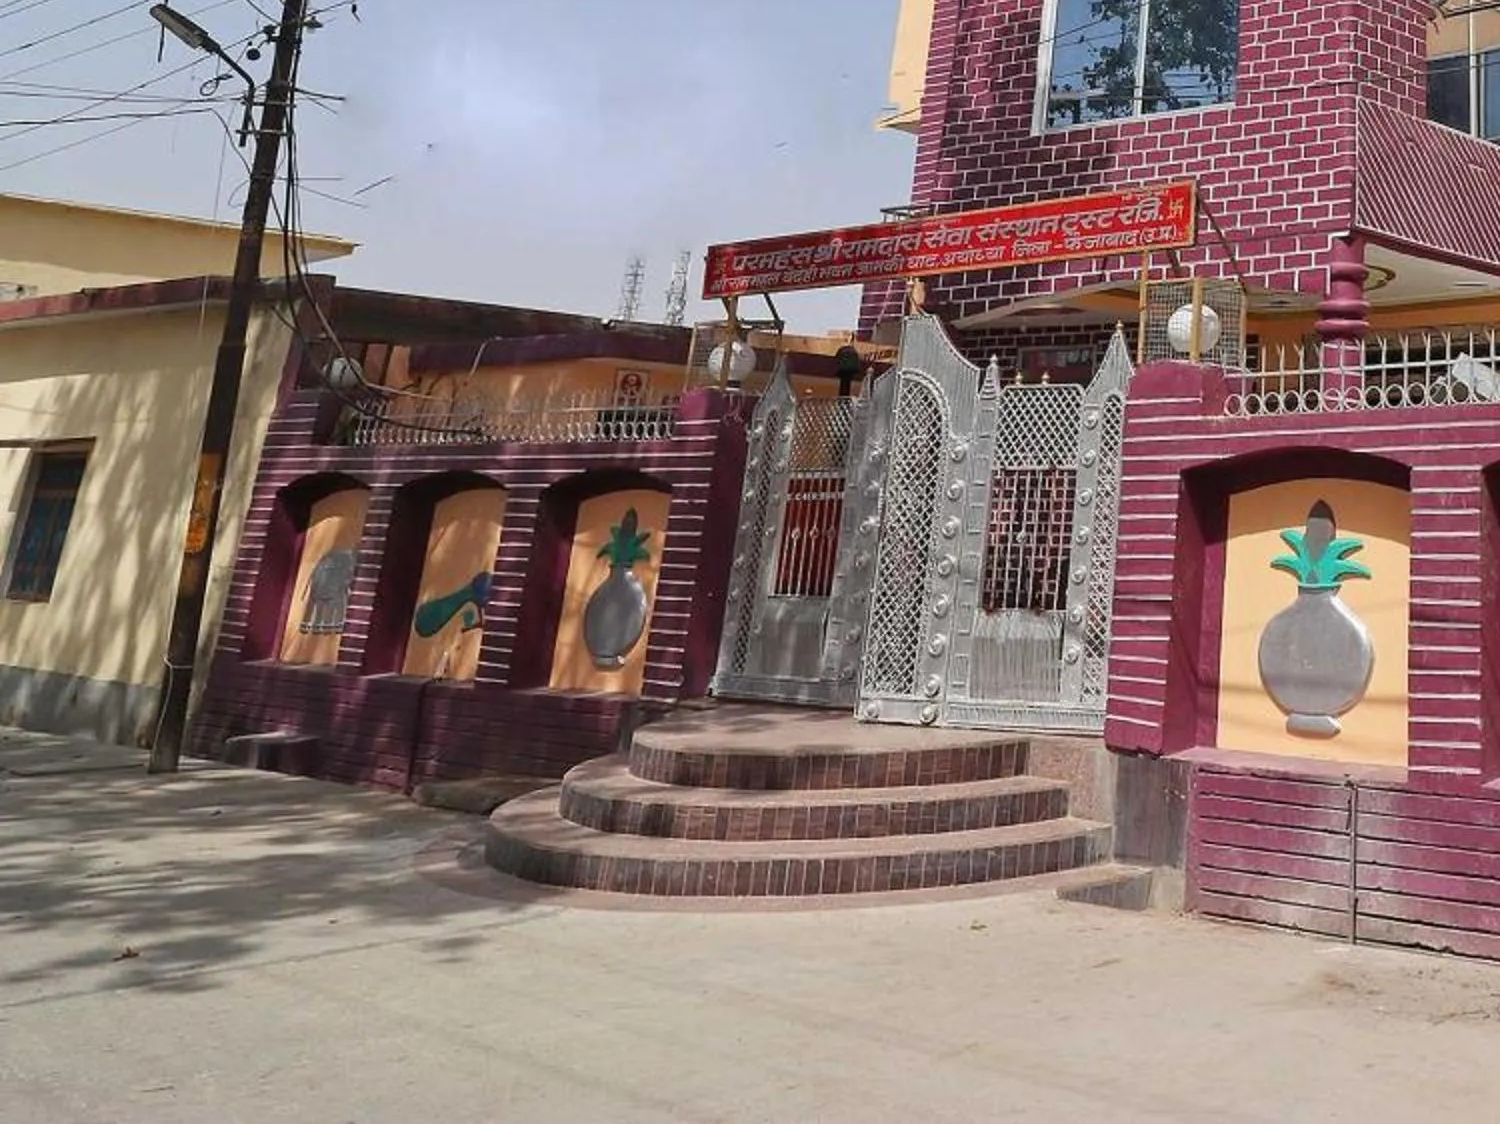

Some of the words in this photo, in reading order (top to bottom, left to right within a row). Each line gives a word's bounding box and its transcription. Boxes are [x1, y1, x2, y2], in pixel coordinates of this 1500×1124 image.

[732, 244, 816, 272] परमहंस
[813, 237, 843, 265] श्री
[842, 232, 922, 260] रामदास
[923, 223, 973, 250] सेवा
[975, 217, 1060, 243] संस्थान
